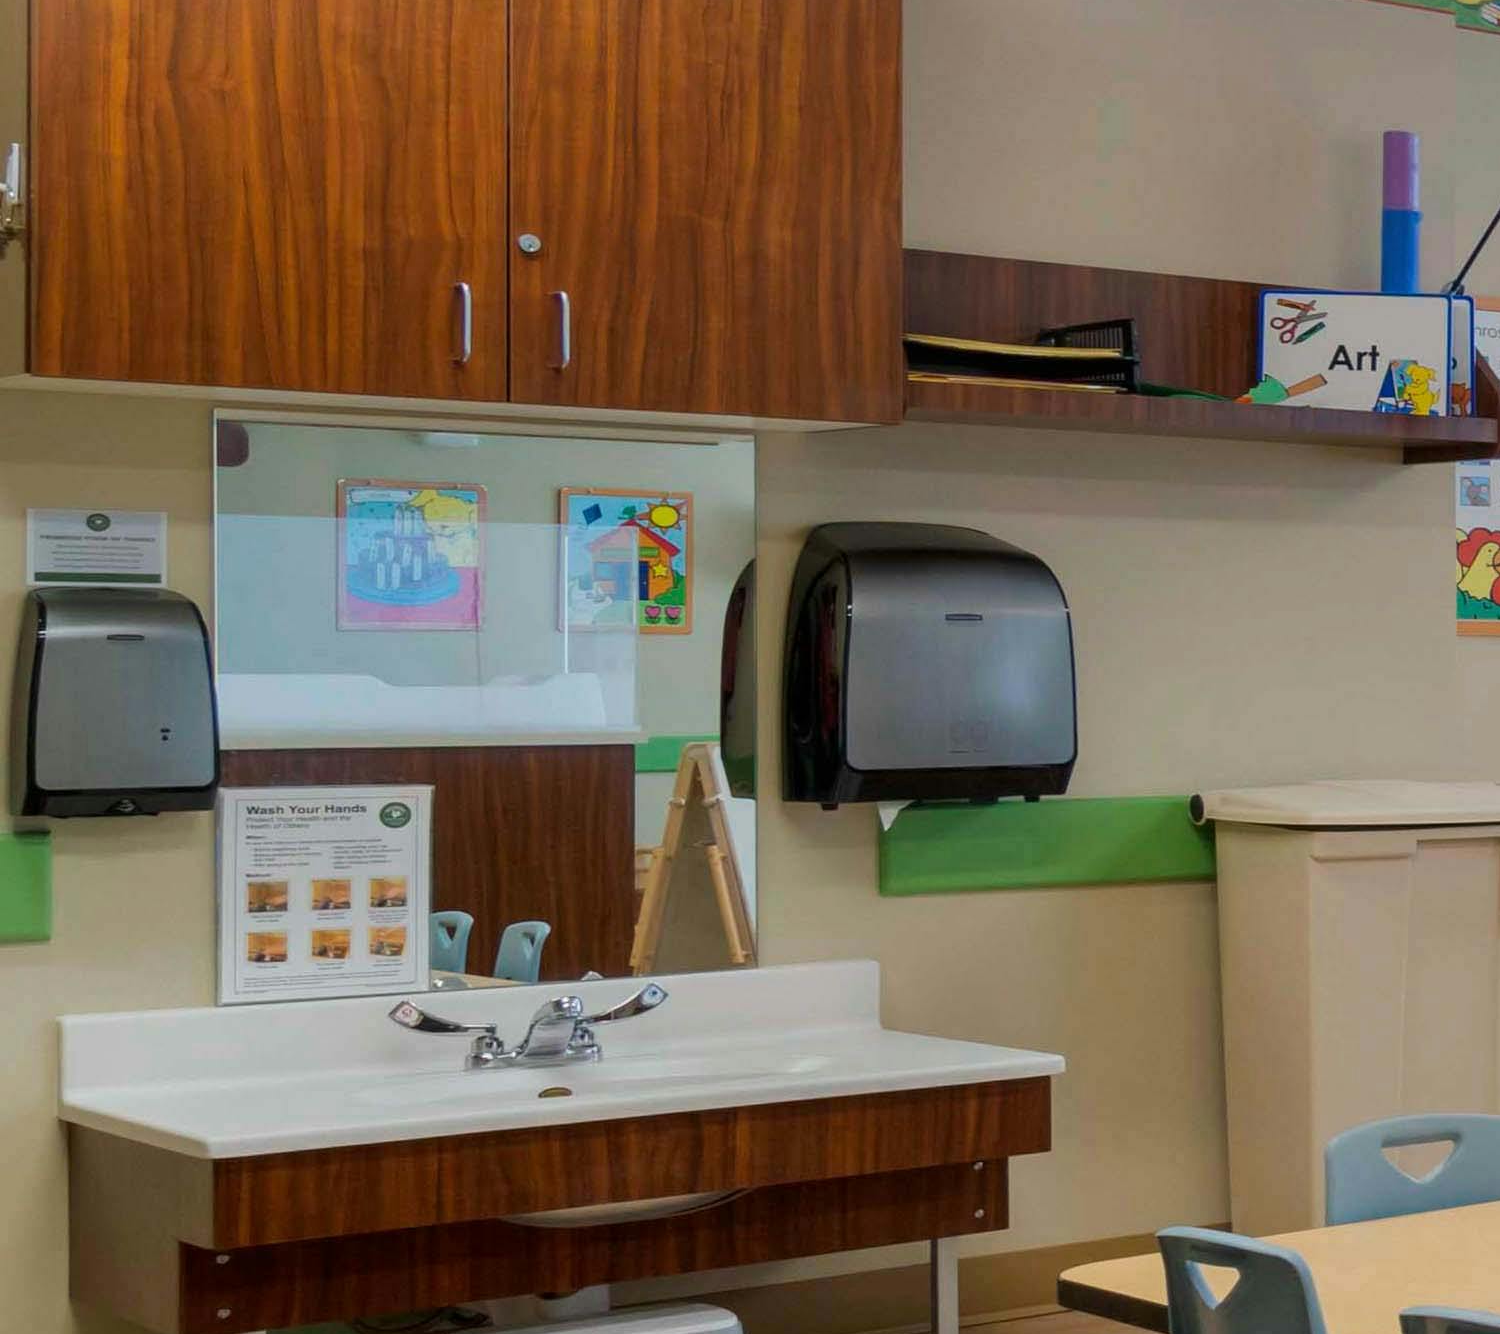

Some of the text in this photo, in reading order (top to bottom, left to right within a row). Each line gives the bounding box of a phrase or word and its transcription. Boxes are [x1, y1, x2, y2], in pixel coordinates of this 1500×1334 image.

[1328, 344, 1381, 372] Art
[246, 803, 368, 816] Wash Your Hands
